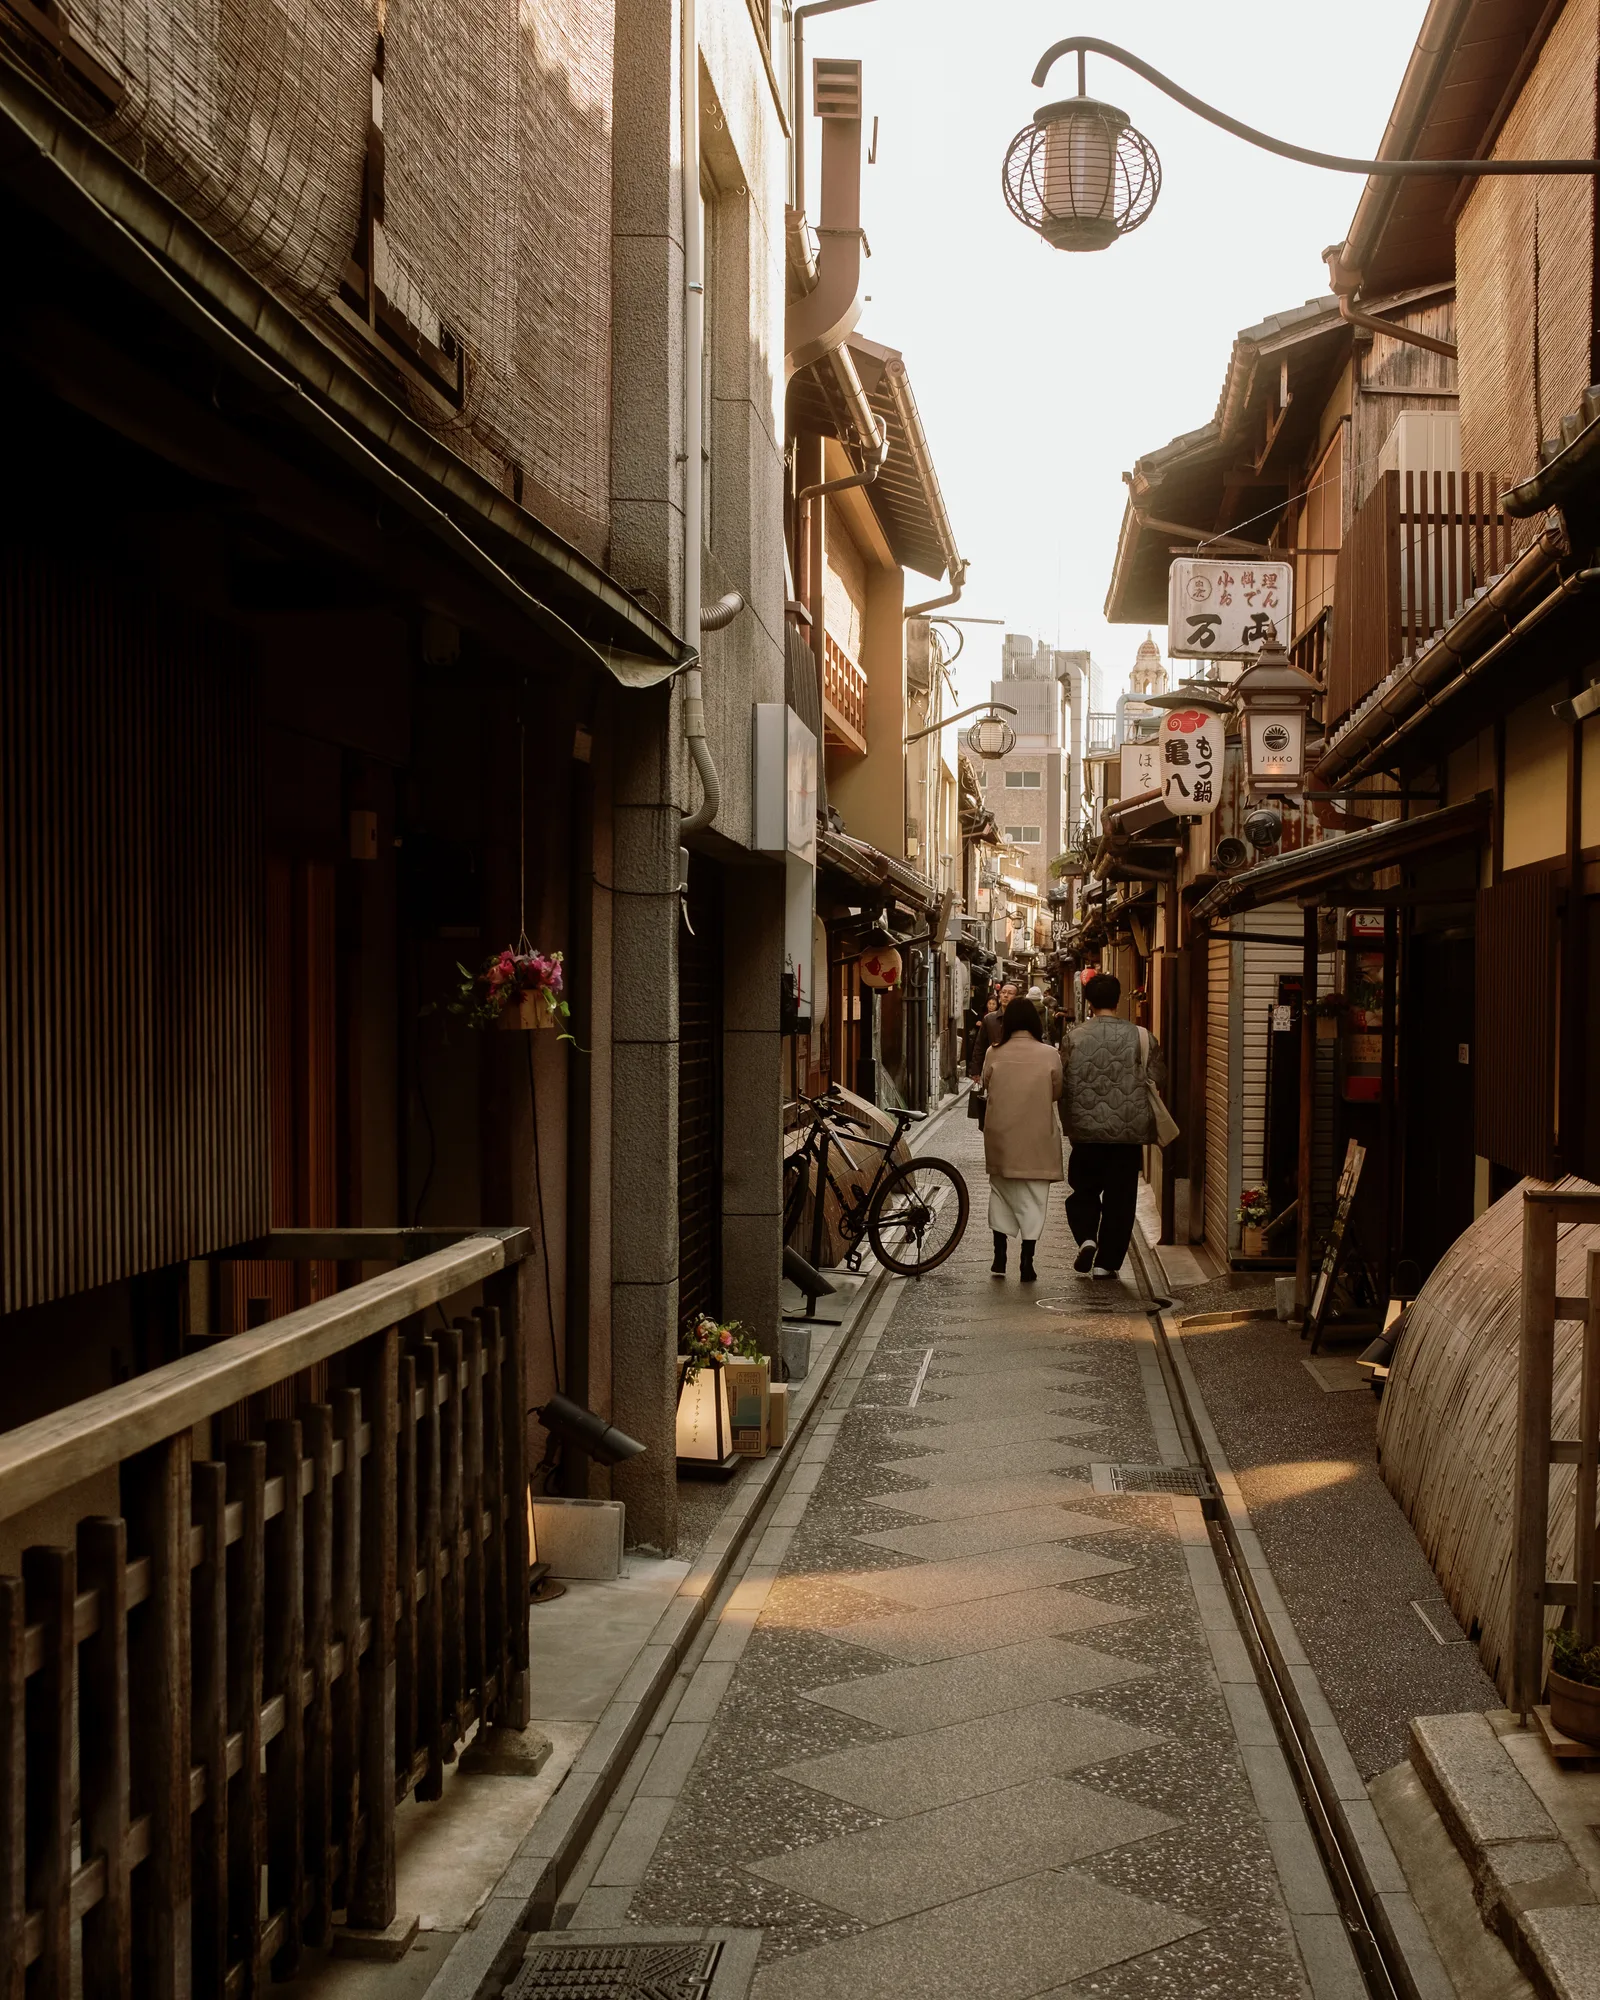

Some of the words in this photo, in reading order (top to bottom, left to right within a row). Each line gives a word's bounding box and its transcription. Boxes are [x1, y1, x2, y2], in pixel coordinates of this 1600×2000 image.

[1217, 570, 1278, 589] 小料理
[1219, 590, 1280, 608] おでん
[1164, 738, 1192, 798] 亀八
[1260, 755, 1293, 763] JIKKO
[1192, 736, 1213, 803] もつ鍋
